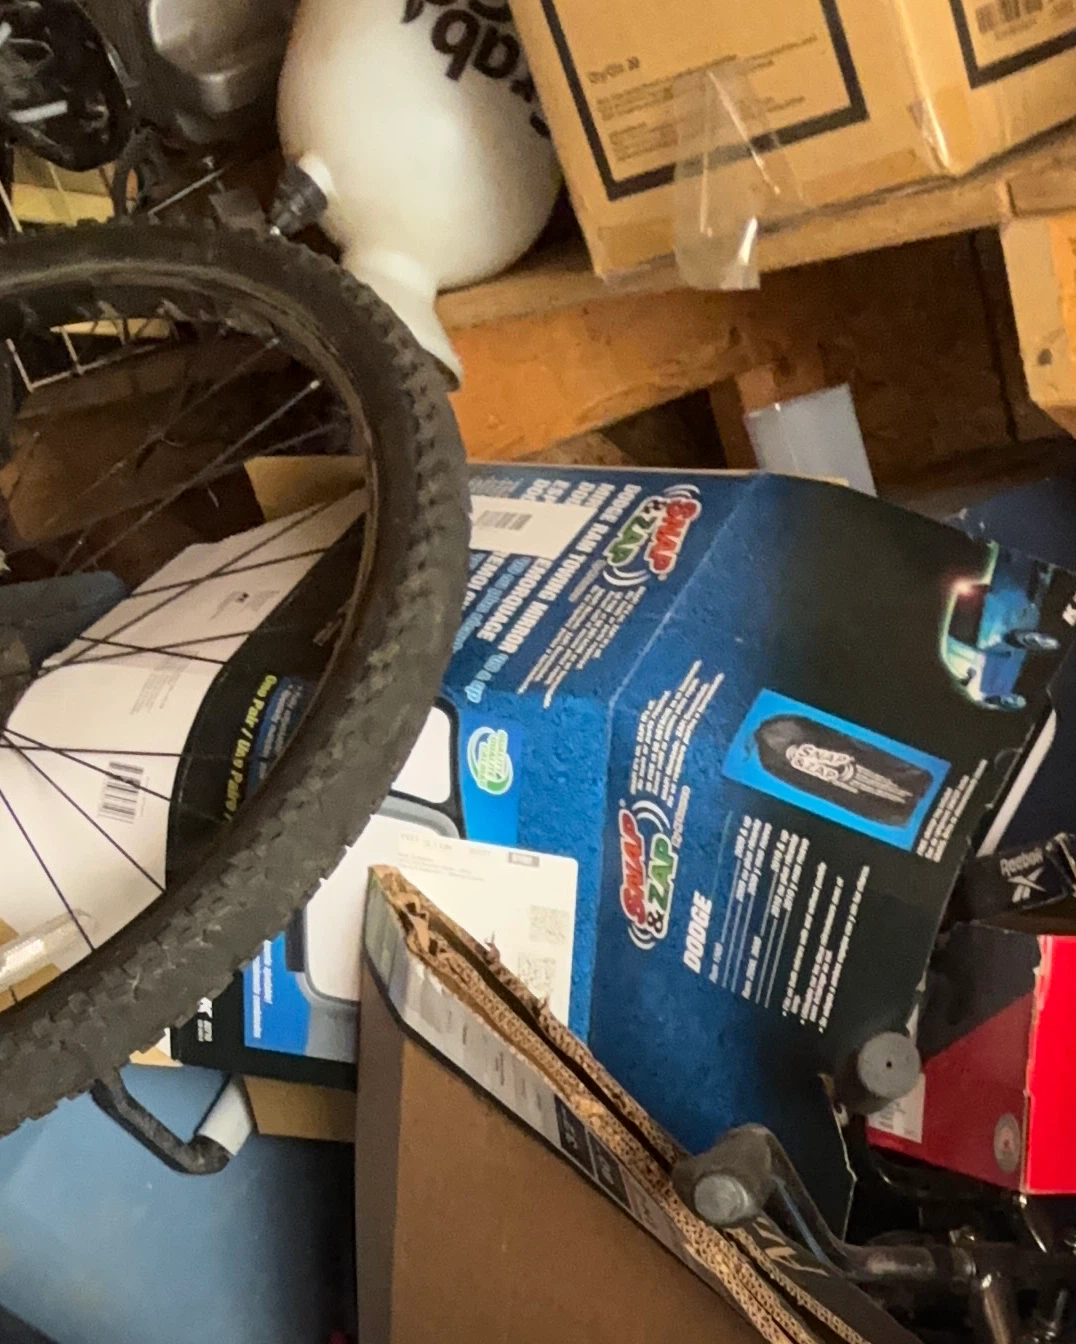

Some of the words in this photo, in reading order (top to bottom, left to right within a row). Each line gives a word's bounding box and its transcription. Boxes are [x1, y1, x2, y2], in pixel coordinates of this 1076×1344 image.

[598, 484, 642, 524] DODGE
[575, 522, 610, 554] RAM
[605, 512, 656, 567] ZAP
[647, 500, 699, 576] SNAP
[475, 558, 552, 640] EMORQUAGE
[536, 552, 587, 602] TOWING
[496, 599, 548, 654] MIRROR
[243, 697, 266, 729] Pair
[618, 808, 645, 924] SNAP
[645, 834, 676, 911] ZAP
[998, 845, 1043, 876] Reebok
[645, 909, 665, 933] &
[682, 889, 712, 973] DODGE
